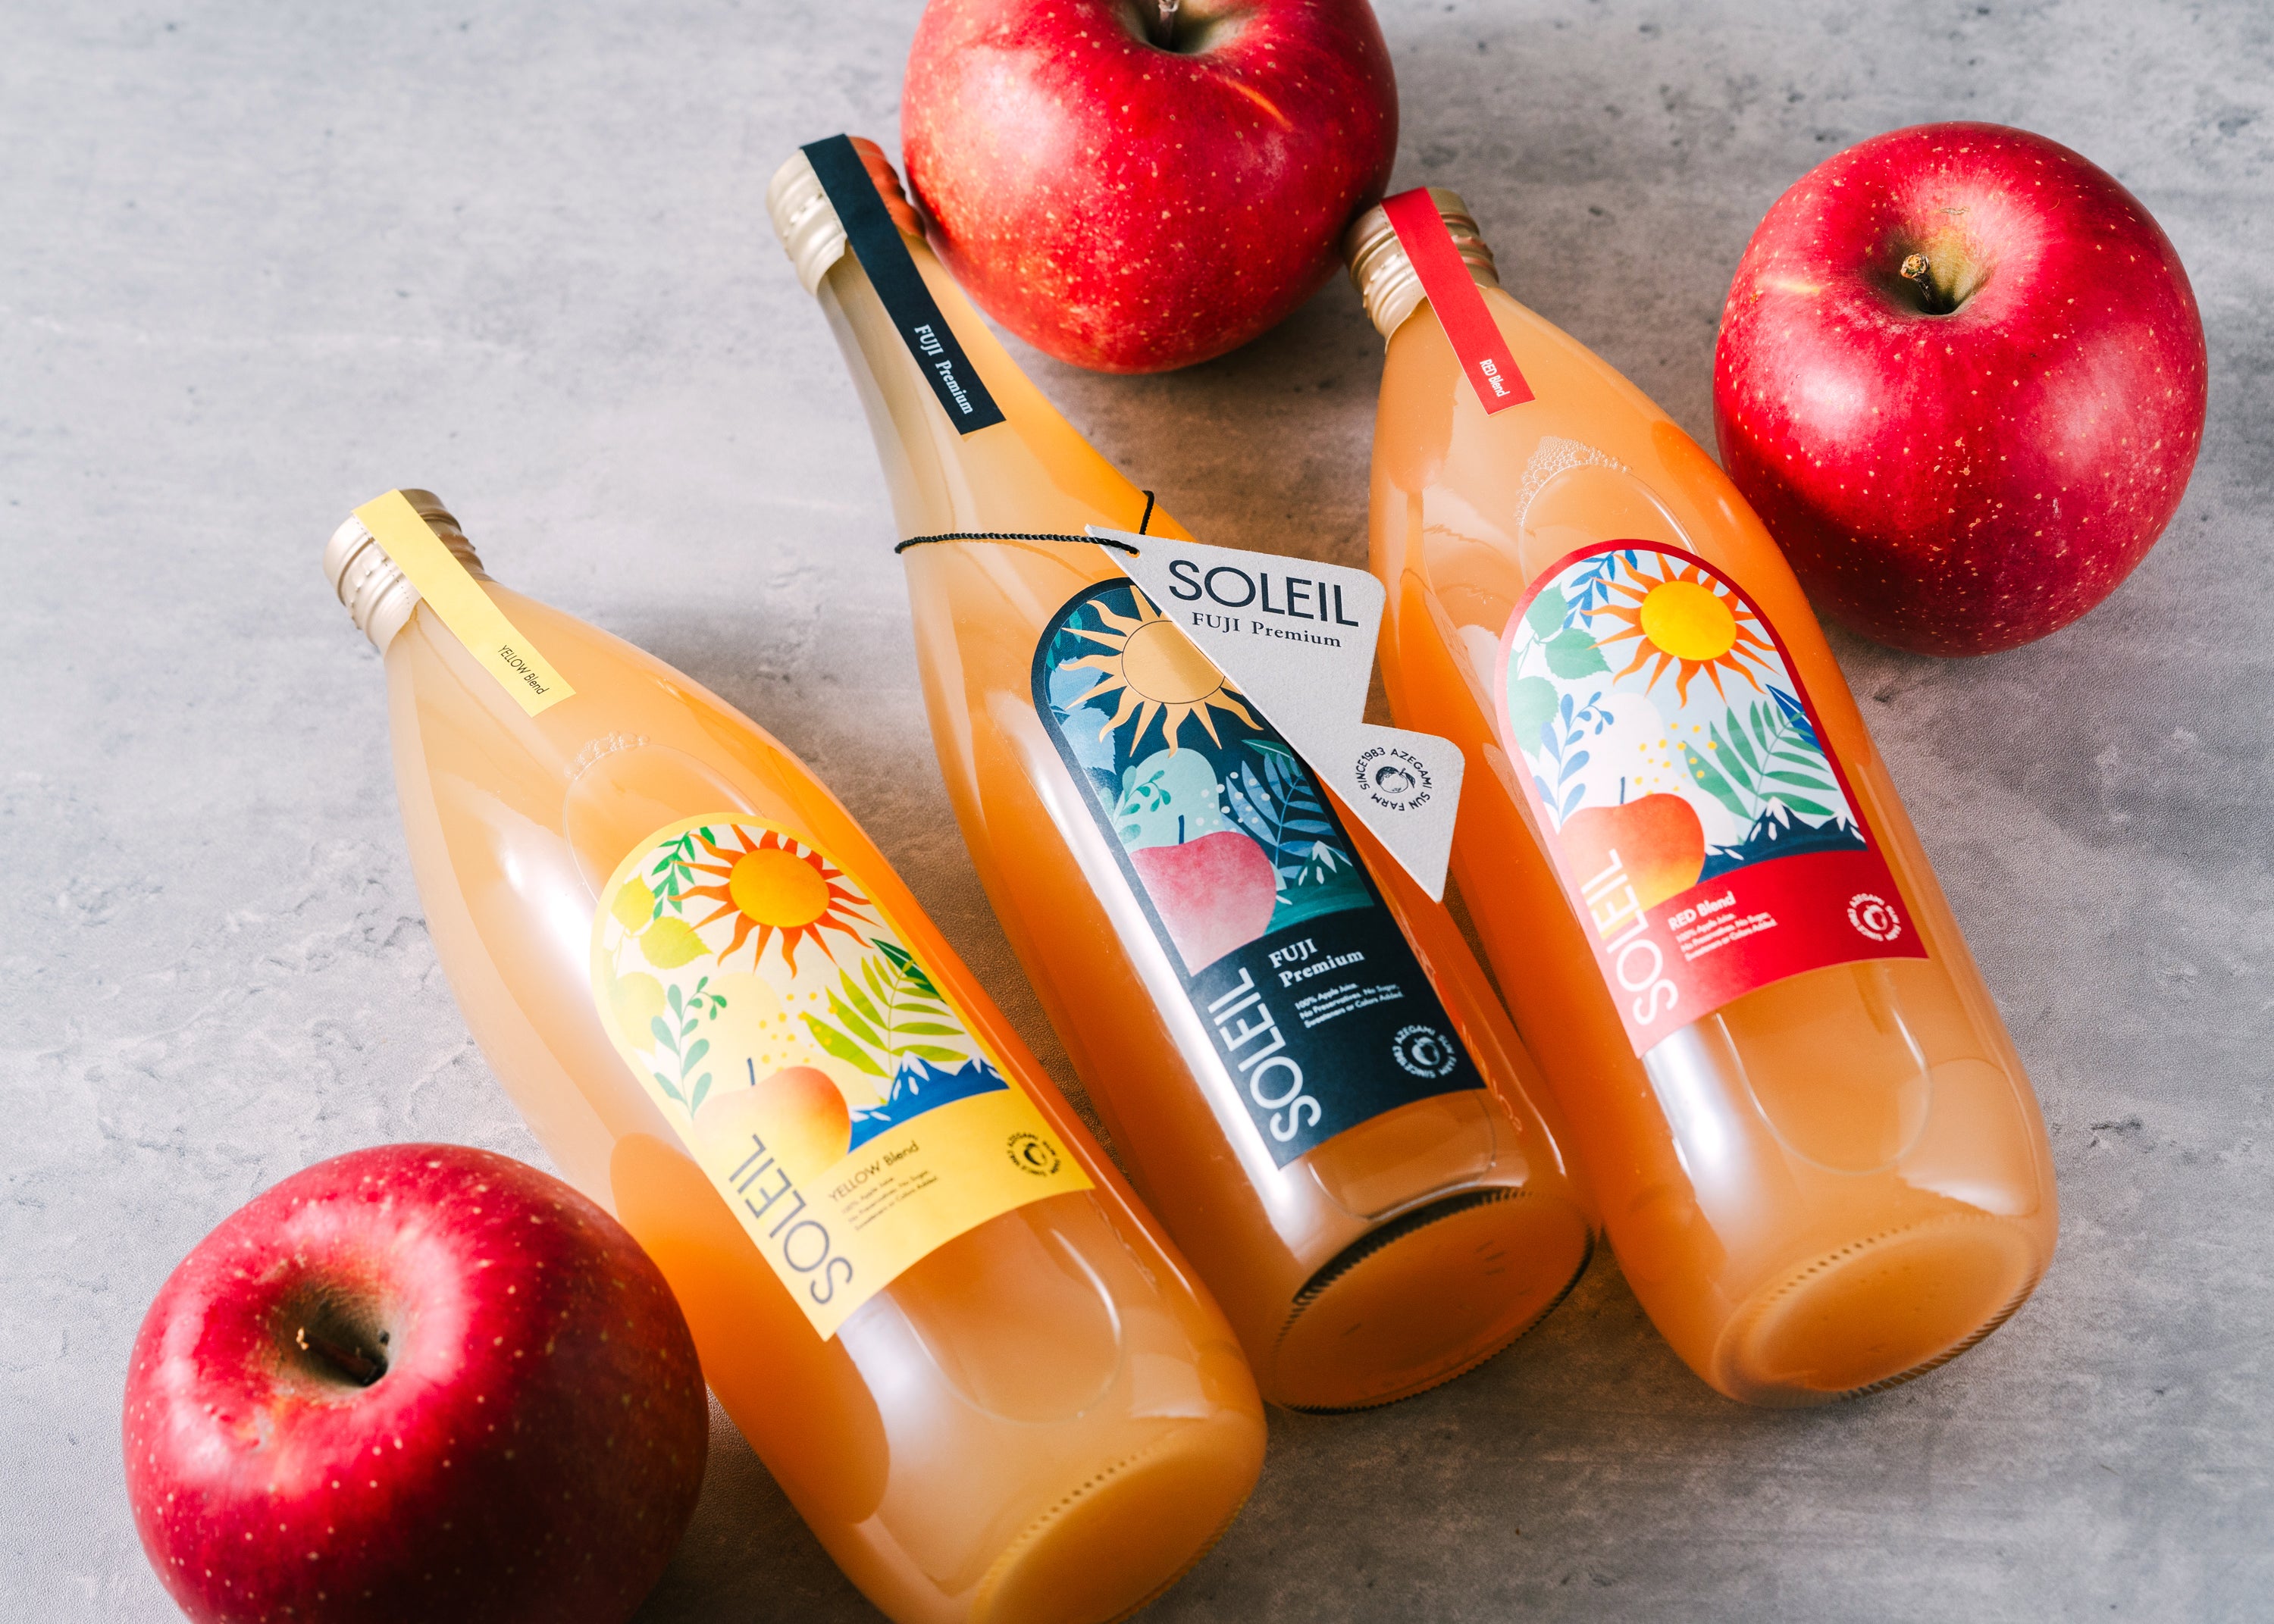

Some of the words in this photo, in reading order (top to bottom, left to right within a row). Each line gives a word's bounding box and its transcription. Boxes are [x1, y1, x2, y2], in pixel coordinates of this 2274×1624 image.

[914, 324, 944, 356] FUJI
[935, 359, 973, 415] Premium
[1479, 358, 1498, 376] RED
[1488, 374, 1511, 397] Blend
[1169, 559, 1359, 627] SOLEIL
[1192, 612, 1241, 633] FUJI
[1251, 621, 1342, 647] Premium
[497, 644, 531, 674] YELLOW
[523, 673, 550, 695] Blend
[1390, 748, 1433, 789] AZEGAMI
[1371, 793, 1405, 812] FARM
[1408, 791, 1431, 809] SUN
[1668, 909, 1697, 931] RED
[1696, 890, 1737, 917] Blend
[1268, 938, 1318, 968] FUJI
[1580, 848, 1679, 1025] SOLEIL
[1278, 951, 1365, 988] Premium
[1207, 967, 1322, 1142] SOLEIL
[828, 1160, 881, 1203] YELLOW
[883, 1140, 919, 1166] Blend
[728, 1133, 853, 1305] SOLEIL
